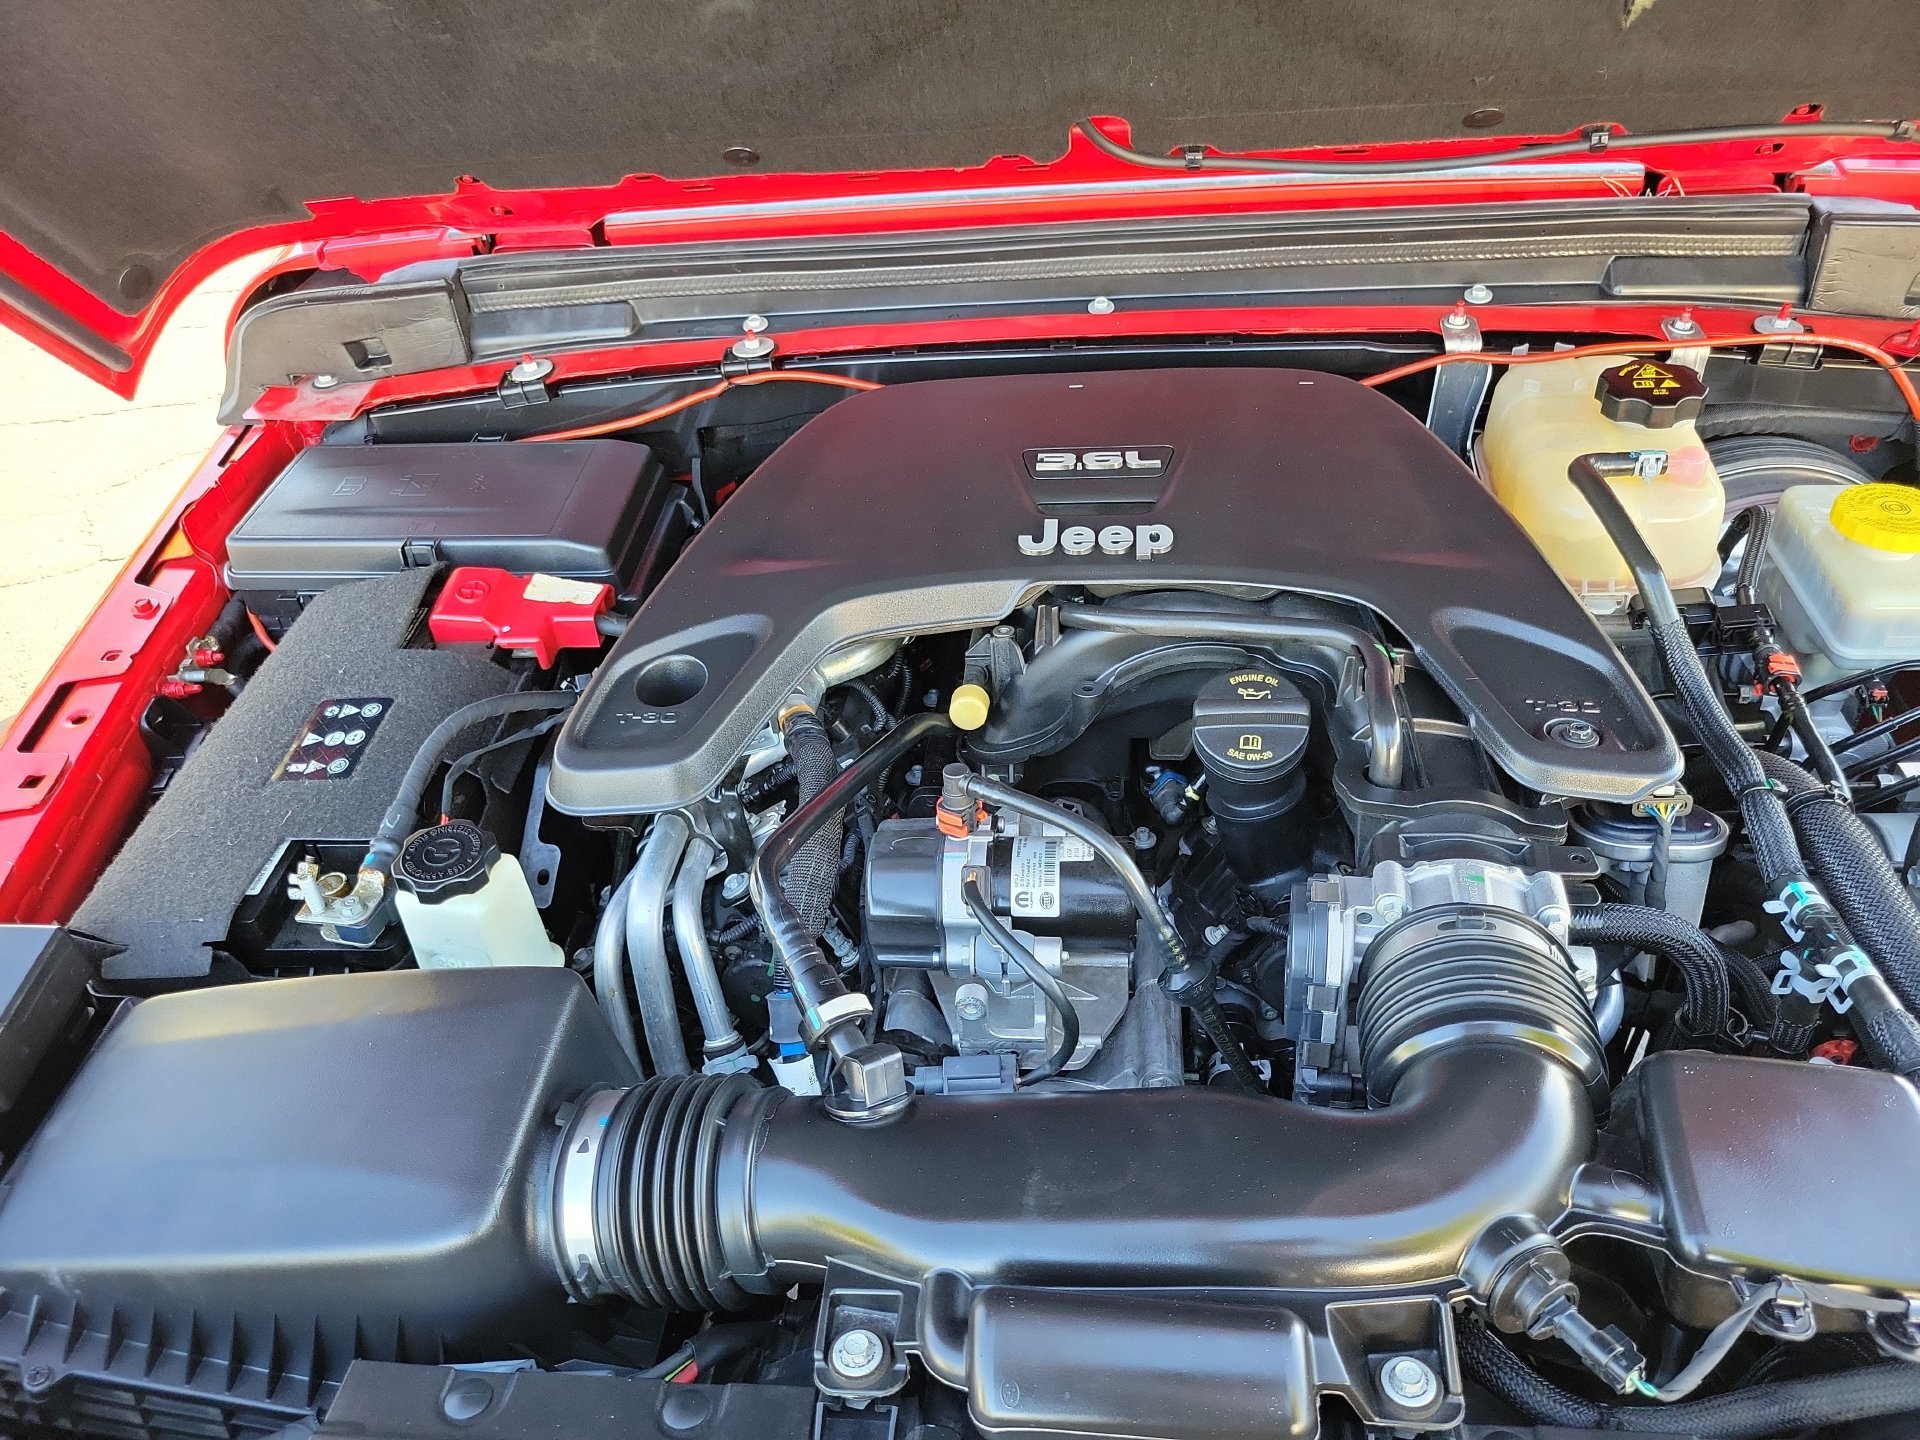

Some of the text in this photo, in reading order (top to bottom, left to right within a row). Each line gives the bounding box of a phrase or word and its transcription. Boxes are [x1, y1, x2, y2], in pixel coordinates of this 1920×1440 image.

[1035, 450, 1162, 471] 3.6L
[1017, 518, 1174, 560] Jeep
[1229, 673, 1279, 687] ENGINE OIL
[1227, 748, 1273, 761] SAE 0W-20
[429, 825, 472, 837] STEERING
[408, 833, 428, 851] FLUID
